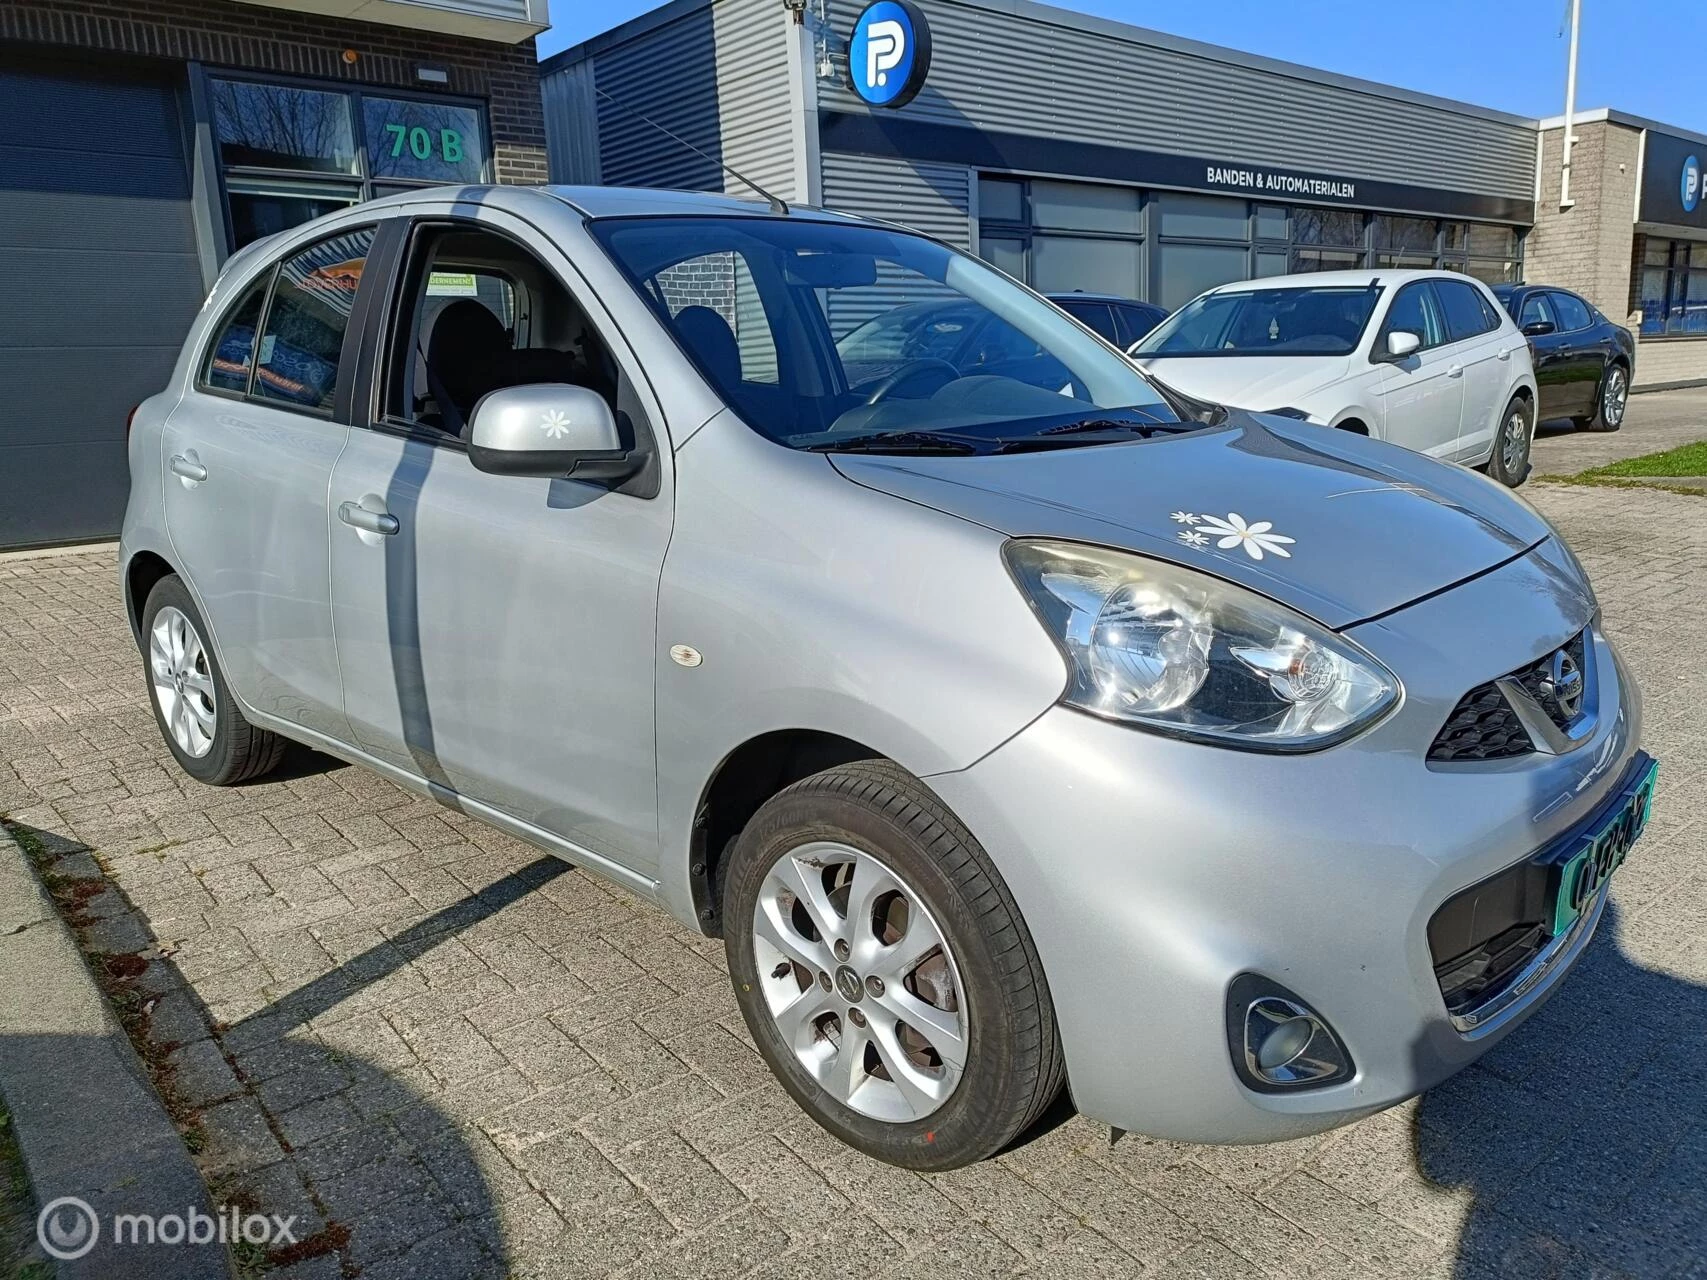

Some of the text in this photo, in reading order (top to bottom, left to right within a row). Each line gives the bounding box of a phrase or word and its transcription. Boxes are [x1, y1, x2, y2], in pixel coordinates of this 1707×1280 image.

[386, 124, 463, 163] 70 B
[1207, 167, 1354, 198] BANDEN & AUTOMATERIALEN
